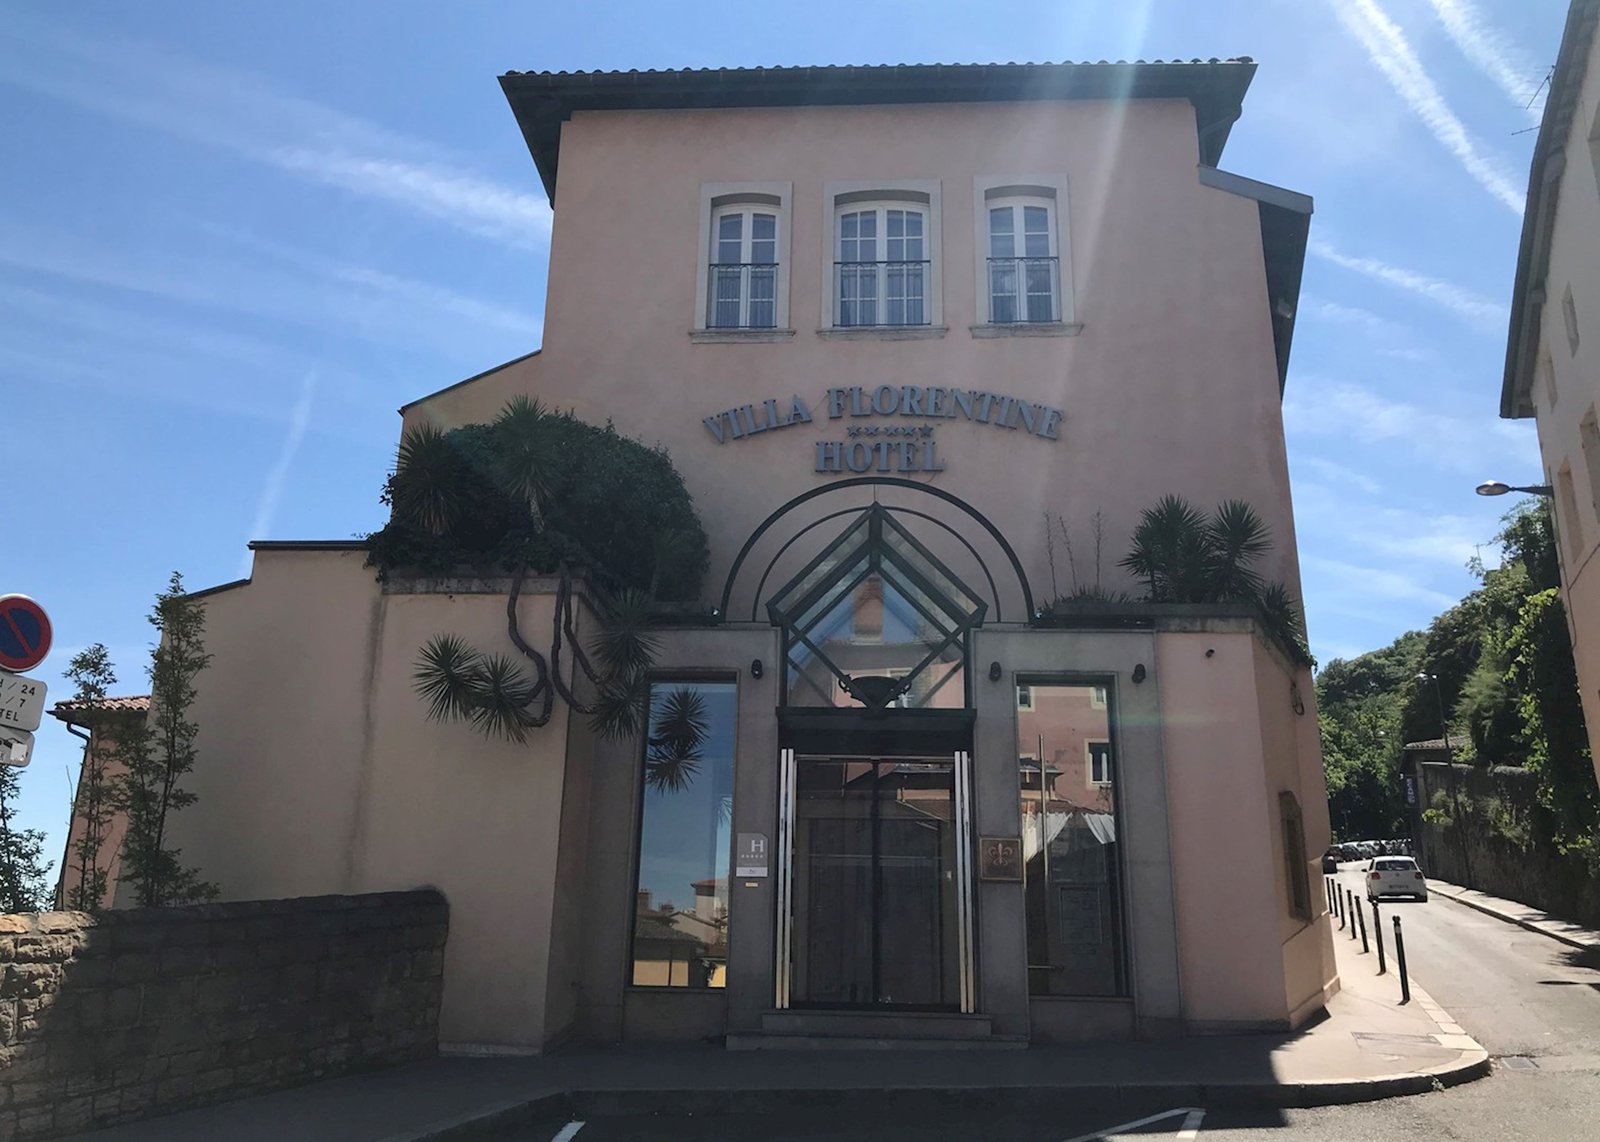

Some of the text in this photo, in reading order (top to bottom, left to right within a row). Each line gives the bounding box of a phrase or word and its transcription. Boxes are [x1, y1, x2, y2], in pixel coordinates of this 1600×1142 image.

[702, 383, 1065, 445] VILLA FLORENTINE
[815, 440, 945, 473] HOTEL
[751, 839, 764, 853] H
